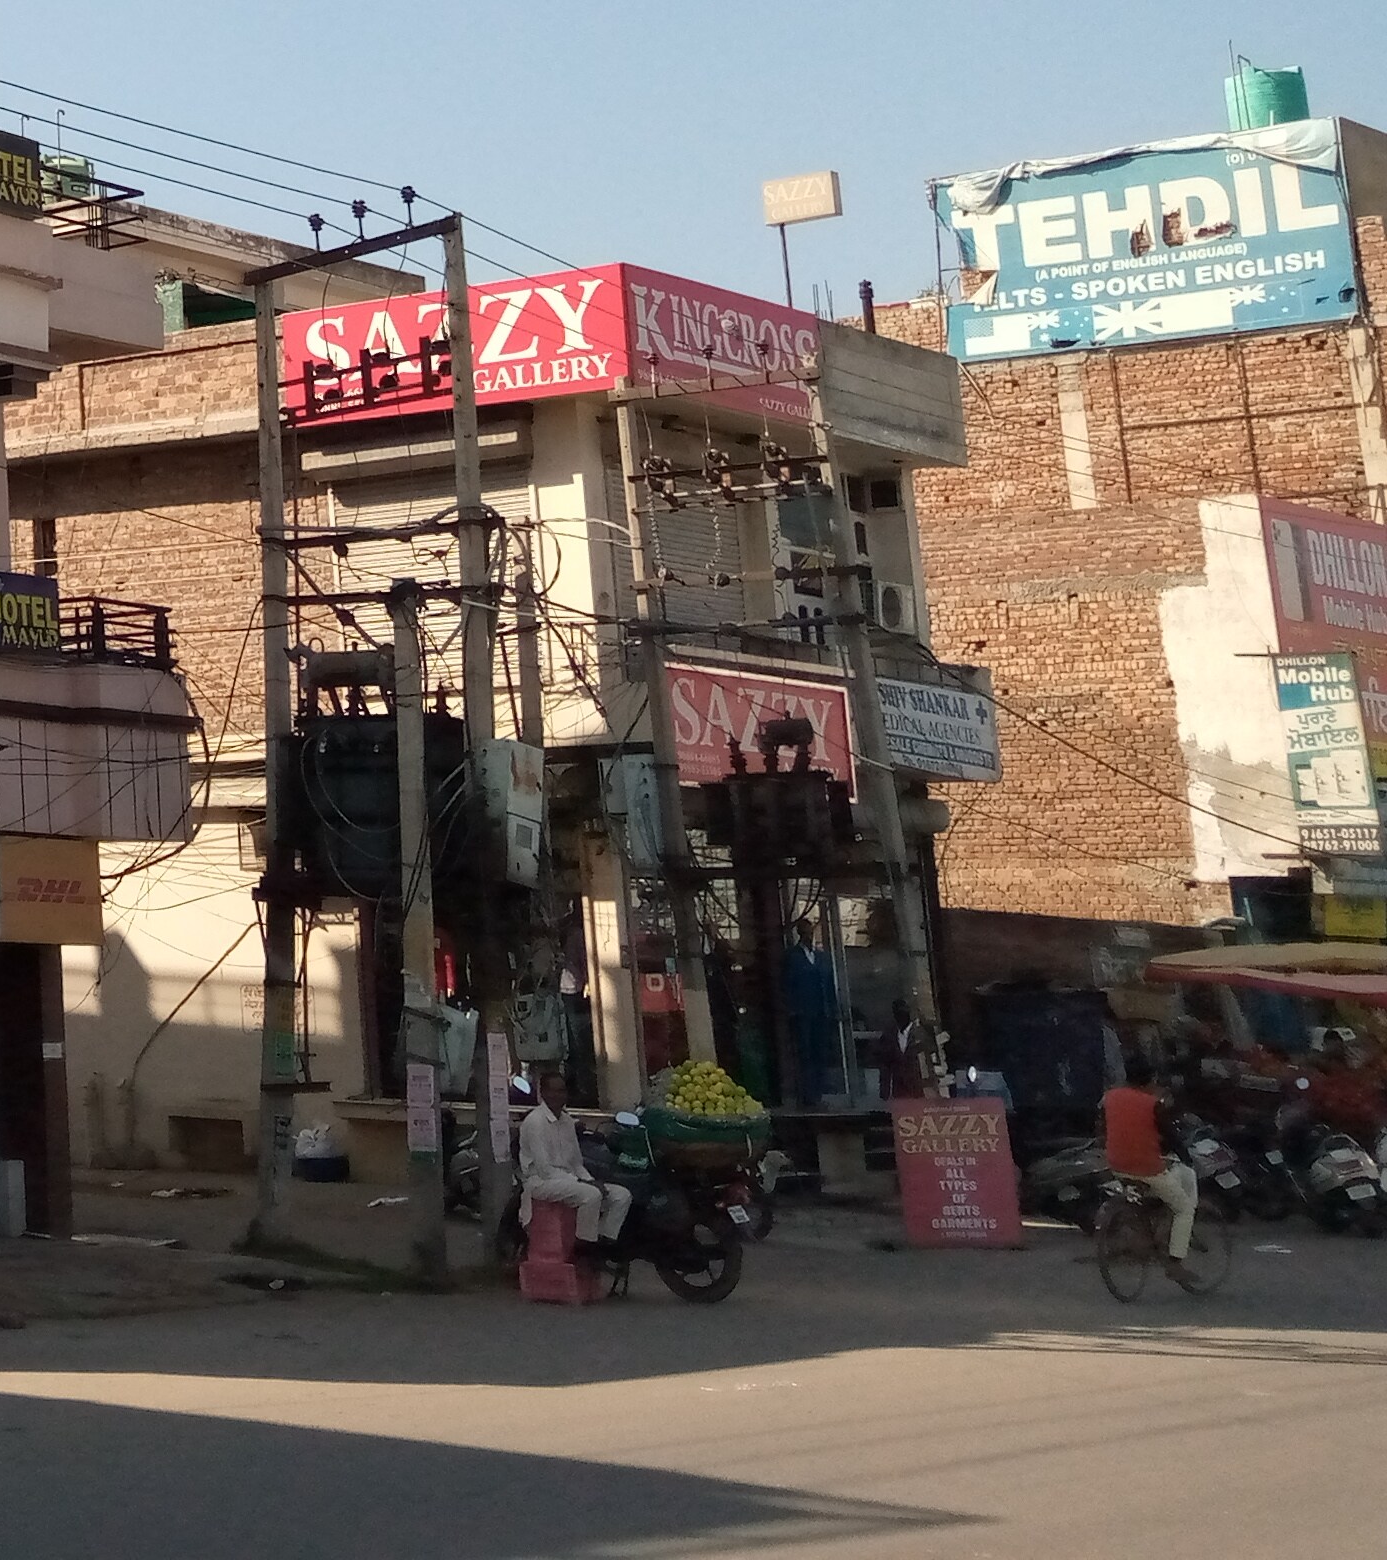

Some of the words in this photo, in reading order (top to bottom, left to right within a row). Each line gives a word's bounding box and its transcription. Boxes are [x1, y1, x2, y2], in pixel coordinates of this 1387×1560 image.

[763, 175, 828, 205] SAZZY
[771, 200, 825, 220] GALLERY
[951, 162, 1340, 268] TEHDIL
[1050, 264, 1090, 278] POINT
[1092, 261, 1109, 274] OF
[1111, 253, 1169, 272] ENGLISH
[1170, 241, 1248, 265] LANGUAGE)
[1071, 268, 1187, 302] SPOKEN
[1195, 248, 1326, 286] ENGLISH
[473, 352, 613, 394] GALLERY
[1306, 528, 1387, 598] DHILLON
[1322, 595, 1364, 631] Mobile
[1276, 656, 1327, 667] DHILLON
[1277, 666, 1351, 684] Mobile
[878, 682, 906, 709] SHIV
[909, 688, 971, 721] SHANKAR
[1309, 685, 1355, 702] Hub
[882, 712, 925, 734] EDICAL
[928, 721, 982, 746] AGENCIES
[17, 876, 87, 904] DHL
[897, 1113, 1000, 1137] SAZZY
[901, 1137, 1000, 1154] GALLERY
[934, 1156, 964, 1167] DEALS
[945, 1168, 967, 1178] ALL
[938, 1180, 978, 1191] TYPES
[952, 1193, 967, 1204] OF
[942, 1205, 980, 1216] GENTS
[931, 1218, 998, 1230] GARMENTS
